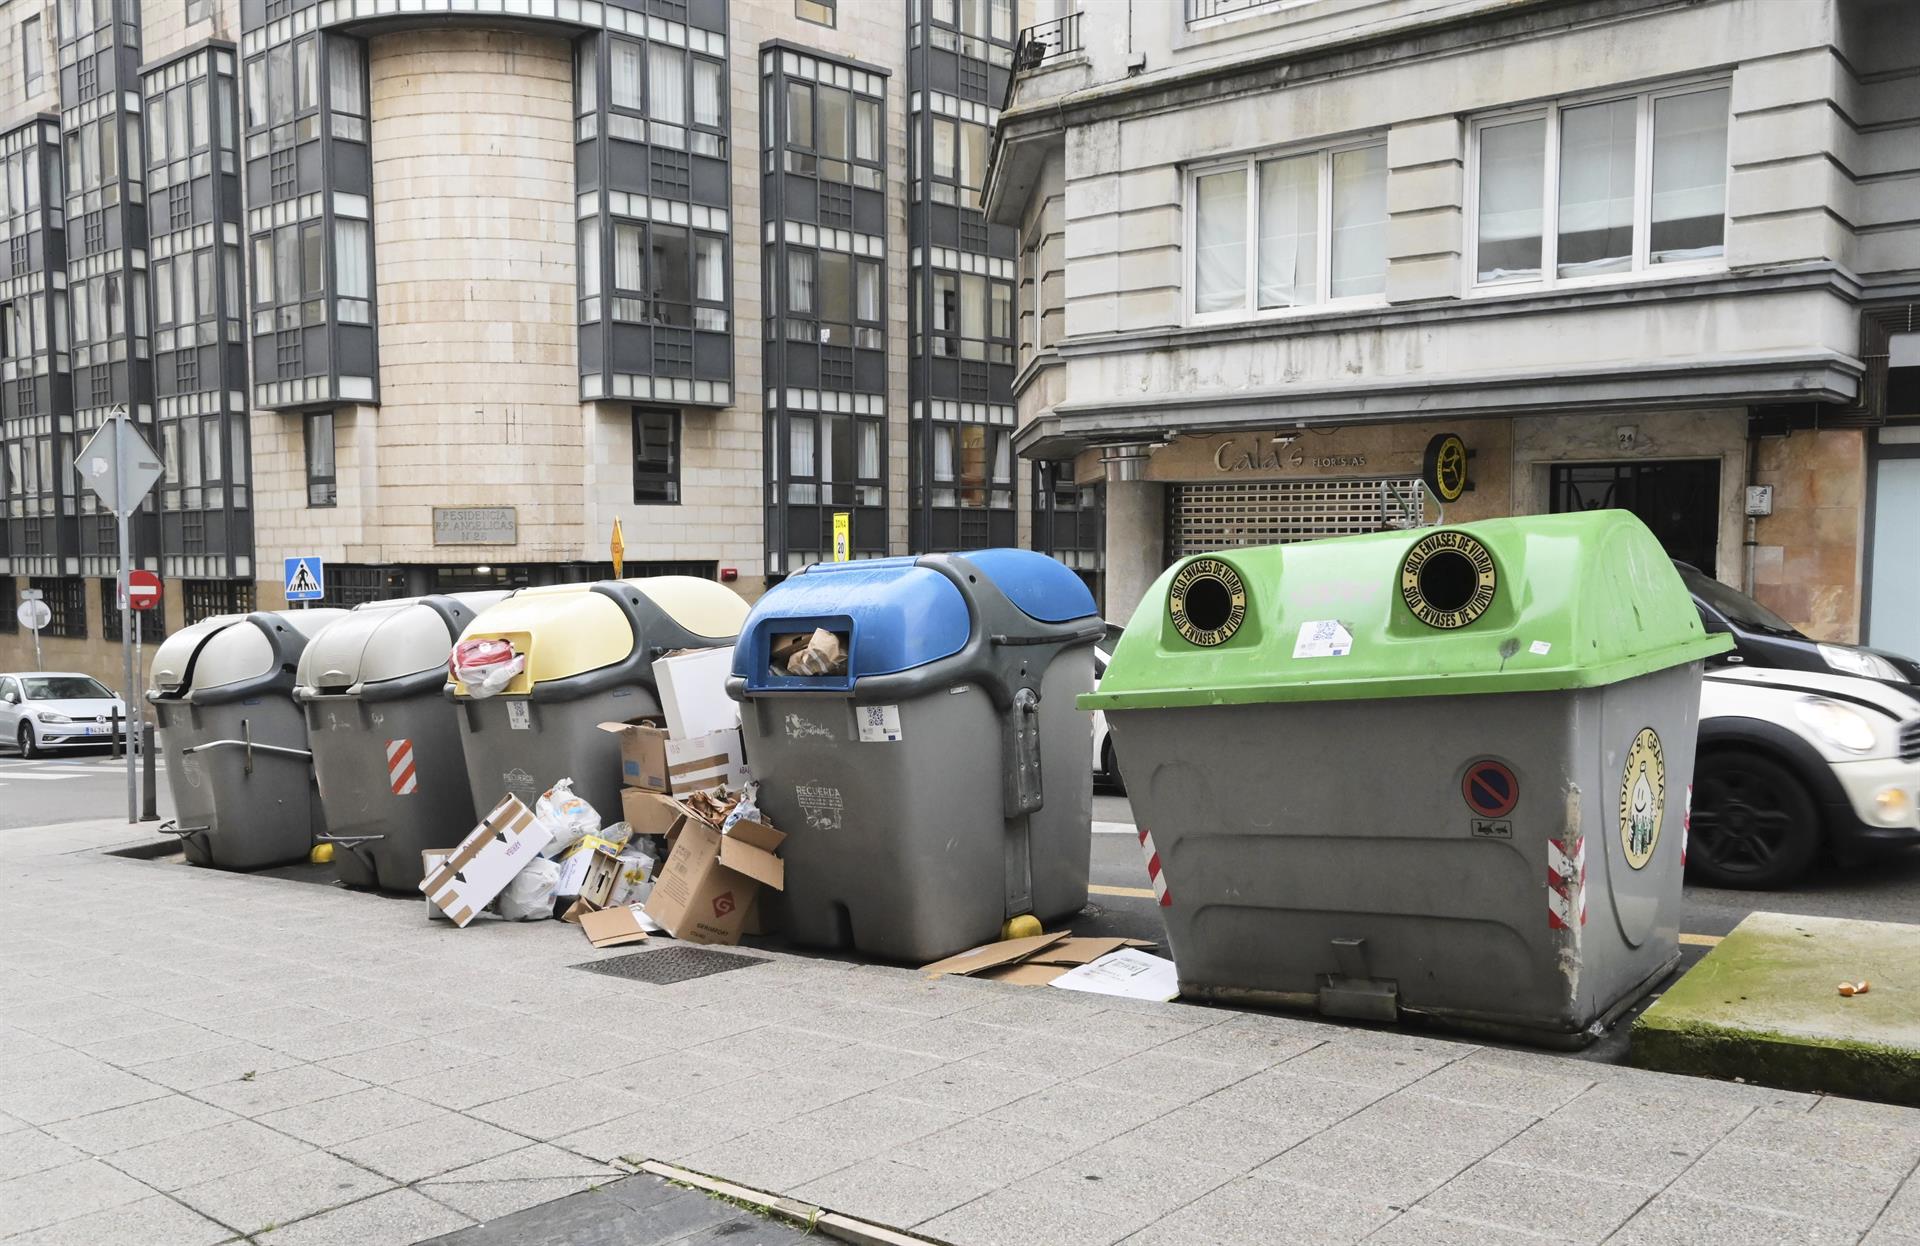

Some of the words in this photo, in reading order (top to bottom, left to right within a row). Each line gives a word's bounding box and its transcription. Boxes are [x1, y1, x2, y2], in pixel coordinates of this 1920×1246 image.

[1620, 433, 1633, 442] 24
[442, 510, 507, 521] RESIDENCIA
[835, 519, 846, 528] ZONA
[837, 542, 844, 554] 20
[1405, 551, 1425, 576] SOLO
[1419, 533, 1457, 556] ENVASES
[1457, 536, 1471, 552] DE
[1468, 542, 1493, 574] VIDRIO
[1172, 578, 1186, 601] SOLO
[1182, 560, 1213, 583] ENVASES
[1213, 562, 1224, 577] DE
[1222, 569, 1242, 596] VIDRIO
[1404, 586, 1421, 609] SOLO
[1417, 605, 1456, 627] ENVASES
[1459, 608, 1472, 624] DE
[1468, 584, 1493, 616] VIDRIO
[1173, 609, 1186, 630] SOLO
[1184, 626, 1216, 645] ENVASES
[1217, 627, 1228, 641] DE
[1225, 605, 1244, 633] VIDRIO
[795, 785, 841, 797] RECUERDA
[1620, 751, 1635, 831] VIDRIO
[1647, 733, 1665, 810] GRACIAS
